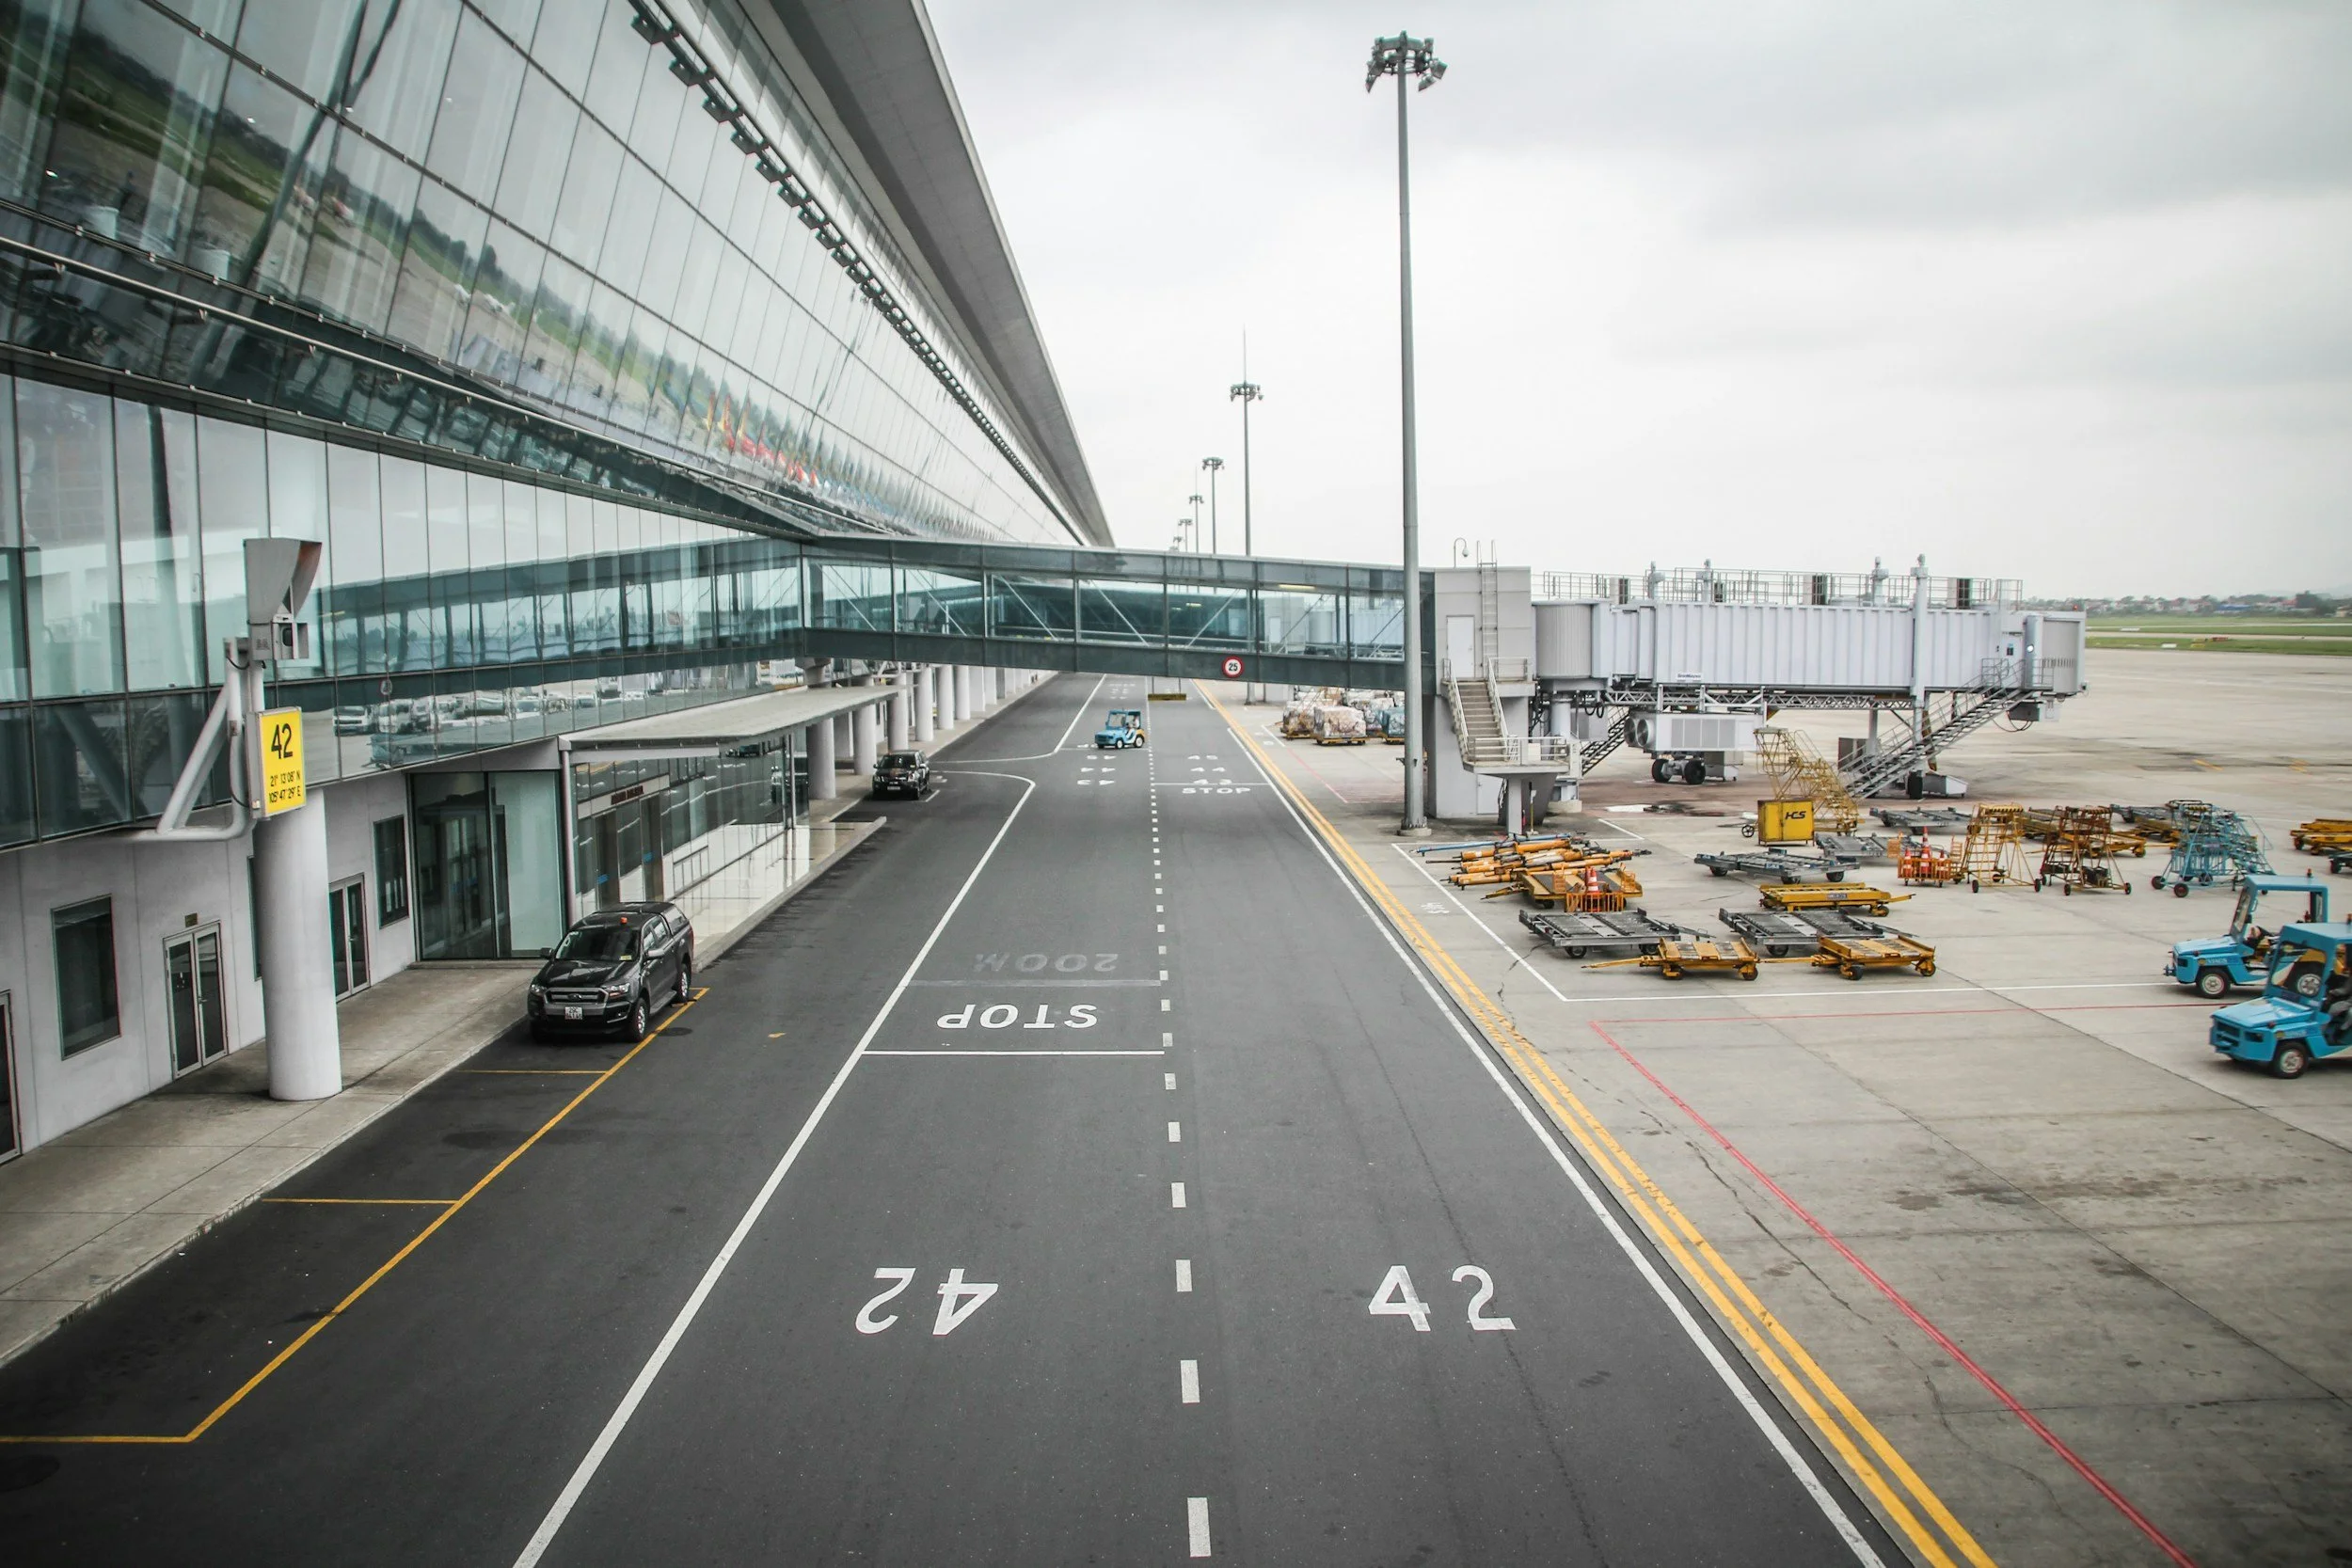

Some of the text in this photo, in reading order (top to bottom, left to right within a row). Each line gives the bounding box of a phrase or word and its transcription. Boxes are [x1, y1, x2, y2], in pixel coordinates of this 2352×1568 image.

[1229, 662, 1238, 672] 25
[271, 723, 294, 759] 42
[936, 1004, 1098, 1029] STOP
[855, 1267, 998, 1335] 42
[1368, 1265, 1517, 1332] 42
